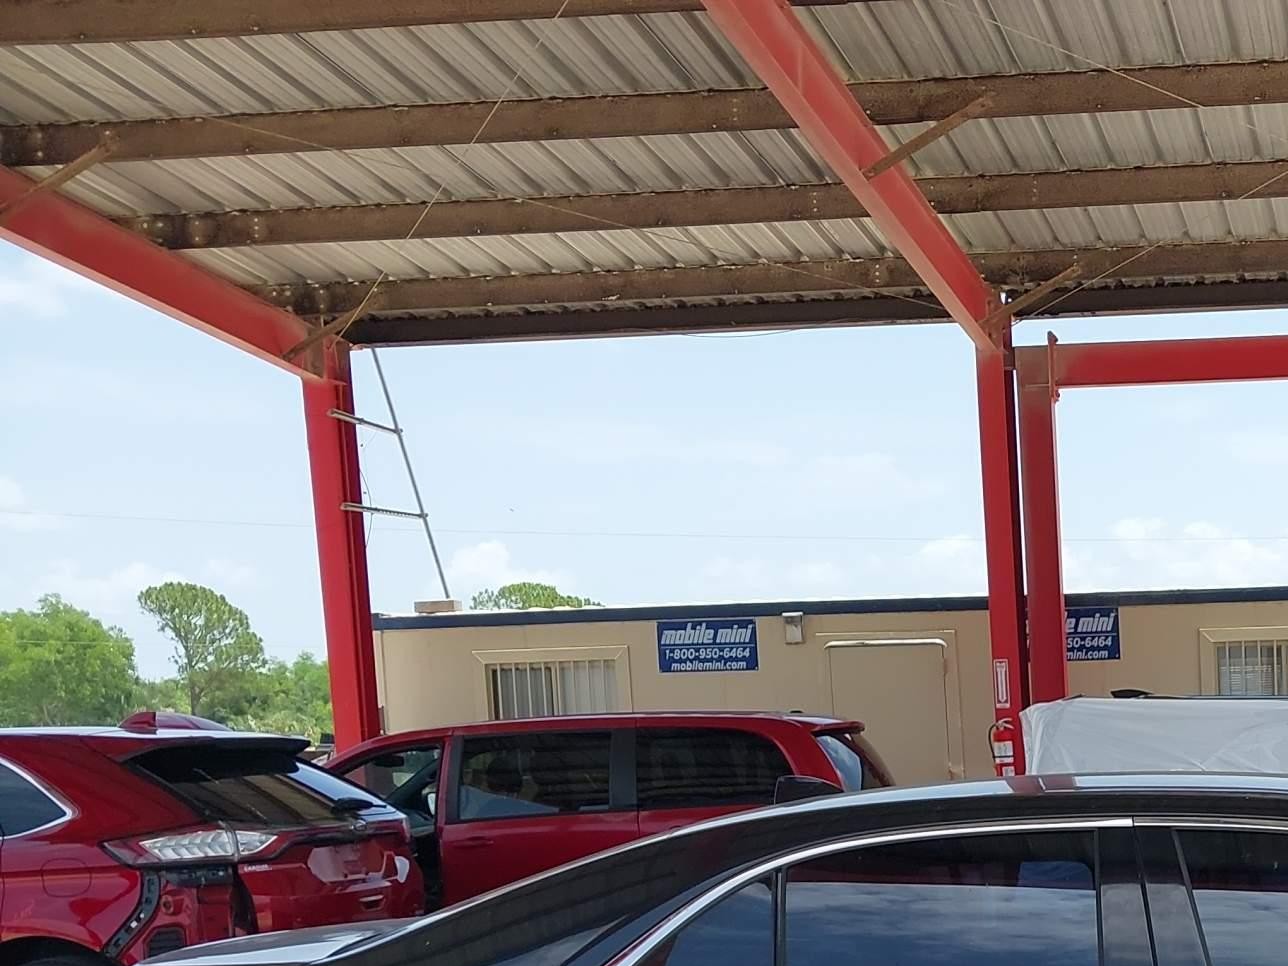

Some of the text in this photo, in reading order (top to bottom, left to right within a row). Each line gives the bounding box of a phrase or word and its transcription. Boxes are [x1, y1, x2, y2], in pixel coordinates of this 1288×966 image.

[1077, 613, 1115, 632] mini
[661, 622, 753, 645] mobile mini
[1067, 636, 1112, 648] 50-6464
[665, 647, 750, 660] 1-800-950-6464
[1067, 649, 1108, 660] mini.com
[671, 660, 746, 671] mobilemini.com
